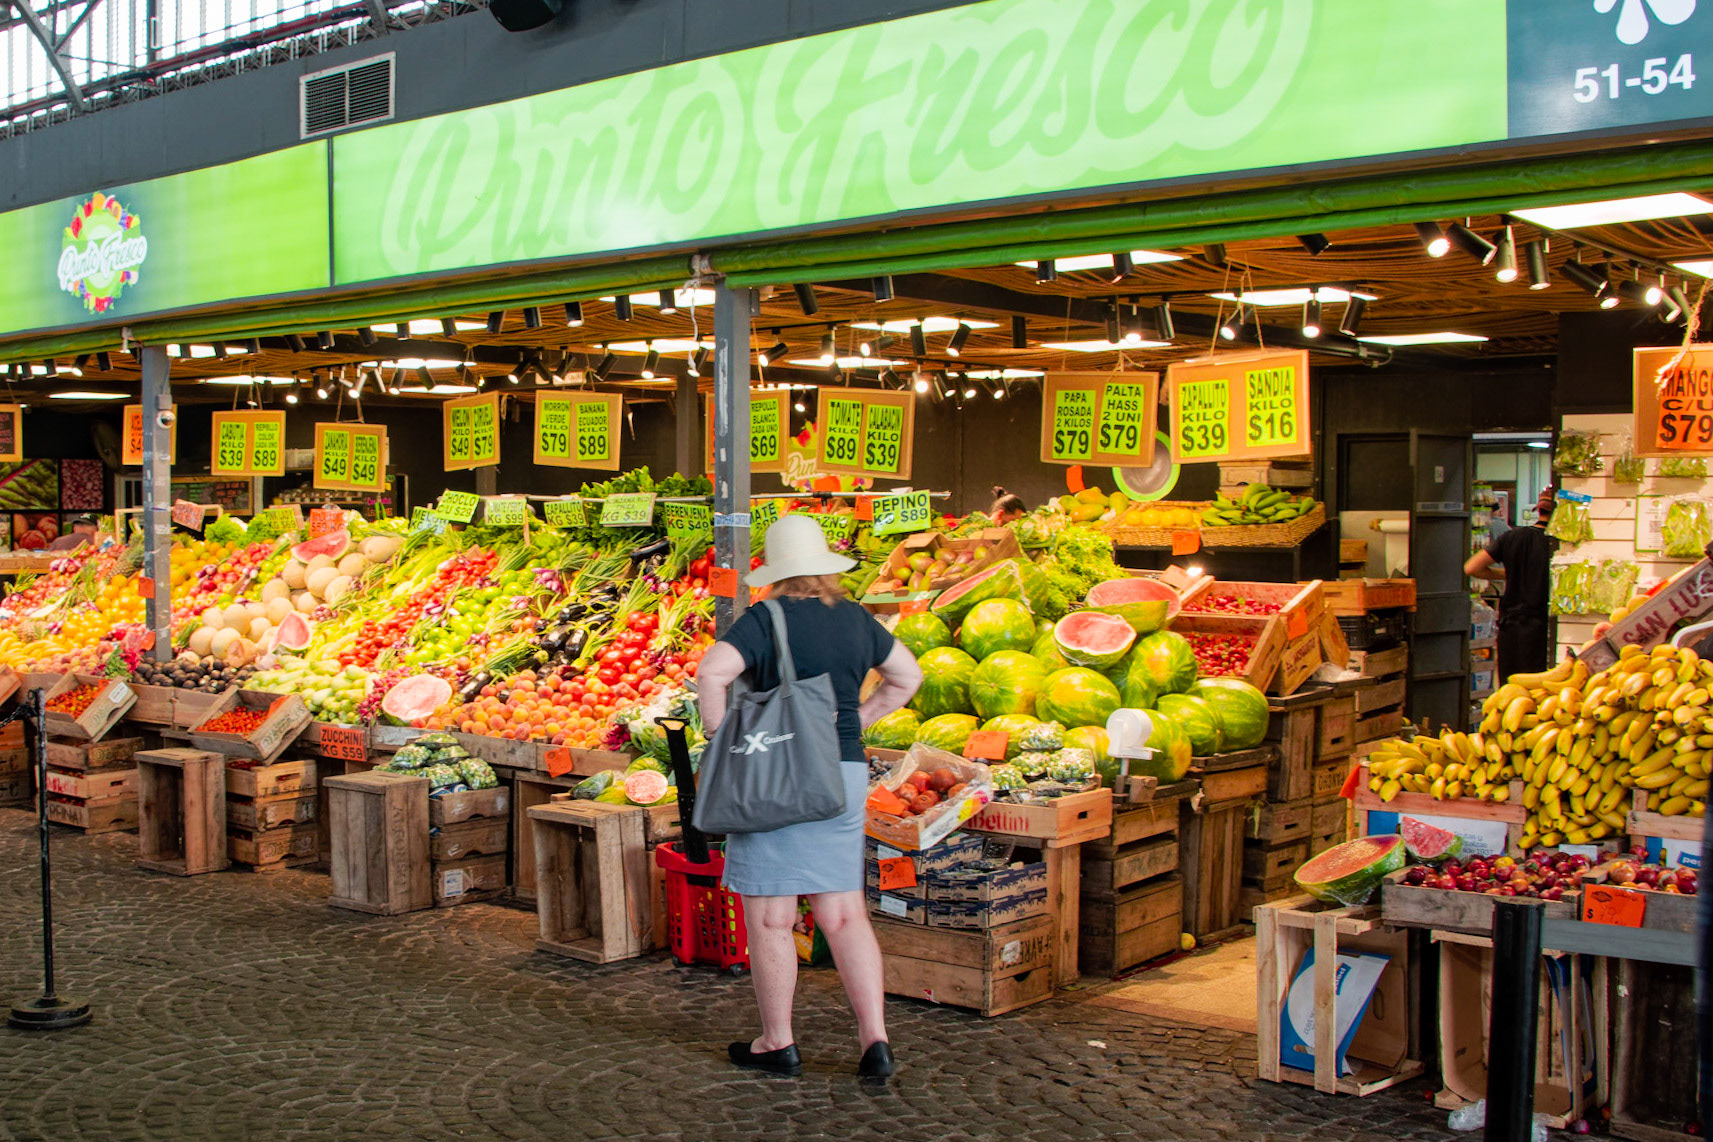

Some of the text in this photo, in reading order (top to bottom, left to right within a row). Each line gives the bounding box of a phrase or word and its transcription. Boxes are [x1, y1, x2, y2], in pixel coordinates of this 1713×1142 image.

[1573, 53, 1696, 103] 51-54
[390, 0, 1290, 270] Punto Fresco
[58, 231, 147, 291] Punto Fresco
[1105, 385, 1141, 397] PALTA
[1249, 370, 1291, 400] SANDIA
[1661, 369, 1713, 397] MANG
[1064, 392, 1086, 403] PAPA
[1107, 399, 1137, 411] HASS
[1182, 383, 1226, 411] ZAPALLITO
[1249, 398, 1292, 411] KILO
[544, 402, 570, 411] MORRON
[579, 404, 605, 414] BANANA
[751, 401, 777, 412] REPOLLO
[829, 401, 860, 427] TOMATE
[1057, 406, 1091, 416] ROSADA
[545, 414, 566, 424] VERDE
[578, 416, 607, 426] ECUADOR
[753, 413, 776, 424] BLANCO
[1056, 418, 1091, 427] 2 KILOS
[1102, 411, 1141, 422] 2 UNI
[1182, 410, 1225, 423] KILO
[452, 428, 470, 436] KILO
[475, 426, 494, 434] KILO
[751, 424, 778, 433] CADA UNO
[828, 426, 859, 434] KILO
[1248, 411, 1293, 444] $16
[1660, 412, 1713, 445] $79
[541, 432, 566, 454] $79
[867, 431, 899, 442] KILO
[1054, 429, 1089, 456] $79
[1100, 422, 1138, 450] $79
[1181, 423, 1225, 455] $39
[451, 438, 470, 456] $49
[475, 435, 493, 456] $79
[579, 434, 606, 458] $89
[750, 434, 776, 460] $69
[826, 436, 856, 461] $89
[219, 449, 243, 466] $39
[253, 450, 276, 467] $89
[865, 441, 897, 468] $39
[323, 458, 346, 475] $49
[352, 463, 376, 481] $49
[444, 490, 475, 506] CHOCLO
[873, 493, 927, 513] PEPINO
[453, 506, 472, 517] $29
[546, 500, 582, 515] ZAPALLITO
[665, 504, 707, 520] BERENJENA
[900, 508, 928, 522] $89
[487, 513, 524, 524] KG $99
[549, 512, 584, 527] KG $39
[602, 510, 646, 522] KG $39
[668, 517, 685, 530] KG
[1621, 609, 1669, 644] SAN
[321, 729, 363, 746] ZUCCHINI
[322, 743, 363, 759] KG $59
